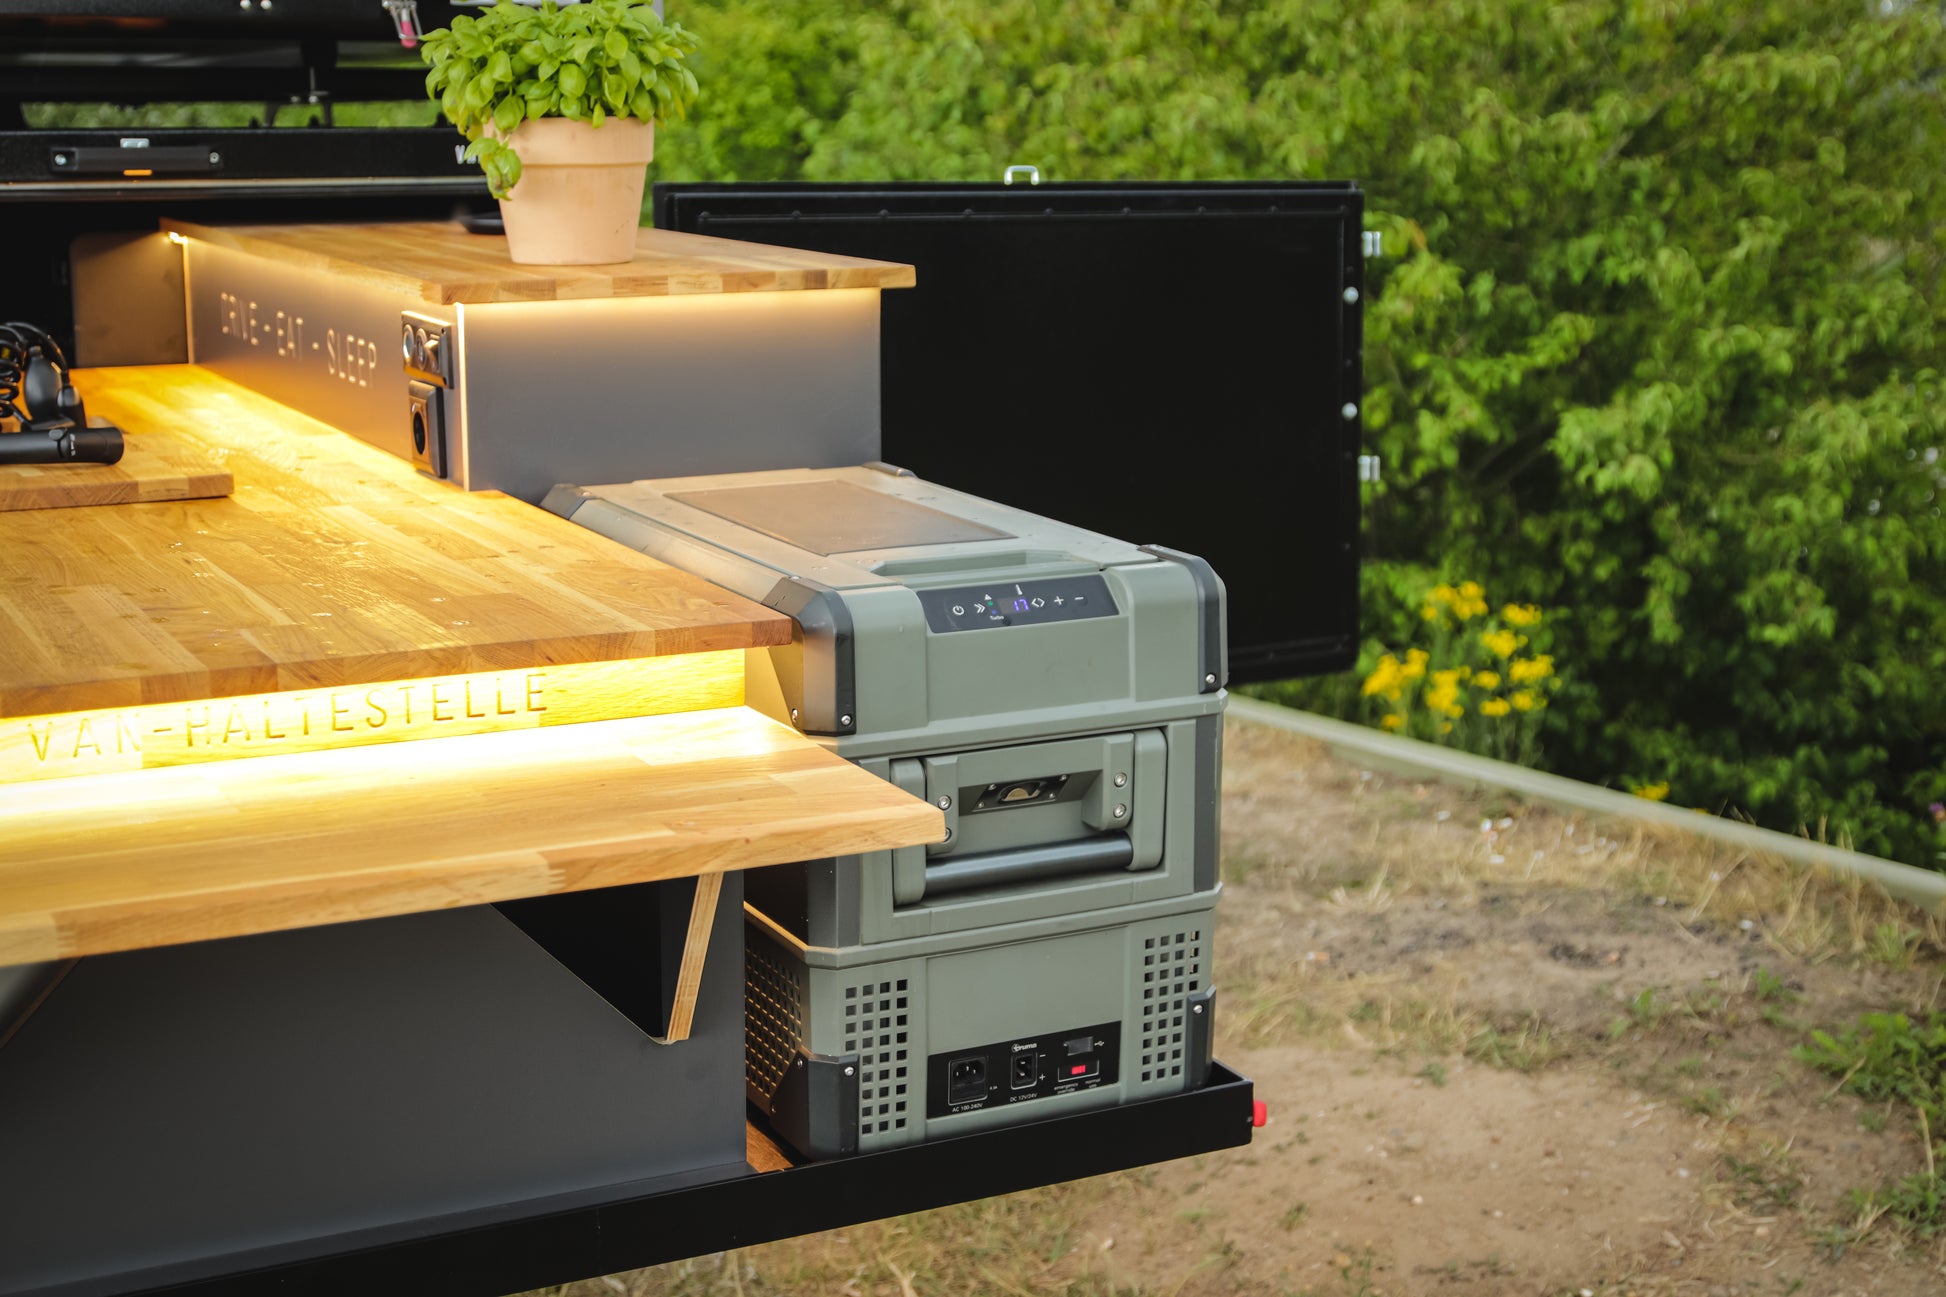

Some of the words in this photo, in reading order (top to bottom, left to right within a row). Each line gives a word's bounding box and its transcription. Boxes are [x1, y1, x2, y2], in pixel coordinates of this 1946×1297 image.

[276, 310, 304, 362] EAT
[327, 328, 377, 389] SLEEP
[1013, 598, 1030, 612] 17
[27, 672, 548, 761] VAN-HALTESTELLE
